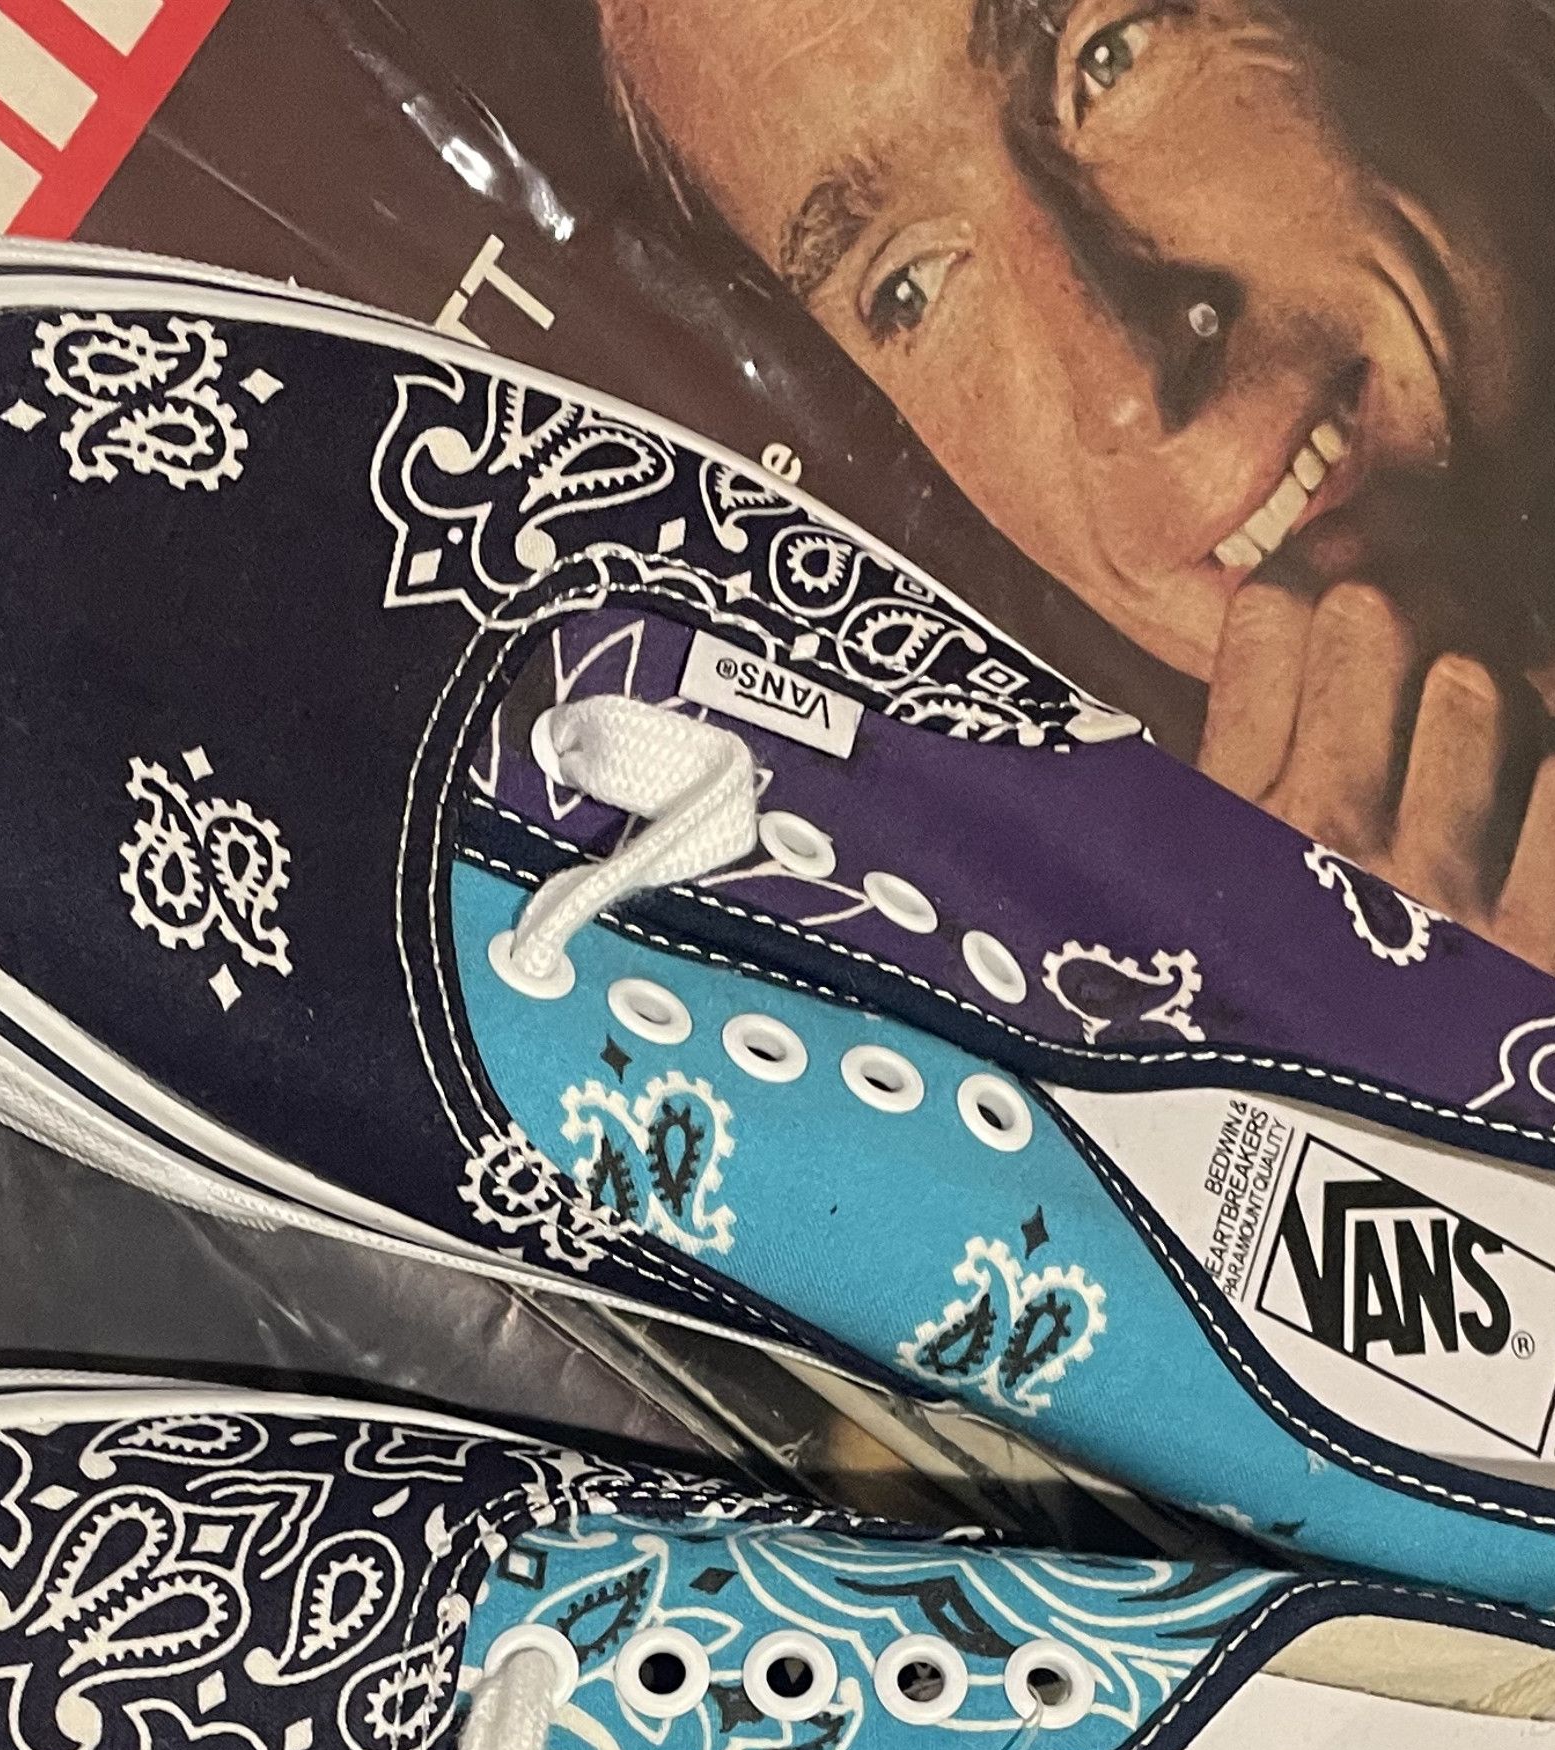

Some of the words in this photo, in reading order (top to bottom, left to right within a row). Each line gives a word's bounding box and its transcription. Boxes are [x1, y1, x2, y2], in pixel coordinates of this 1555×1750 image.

[1204, 1113, 1243, 1195] BEDWIN
[1204, 1106, 1269, 1280] EARTBREAKERS
[1223, 1190, 1264, 1299] PARAMOUNT
[1253, 1115, 1287, 1191] QUALITY
